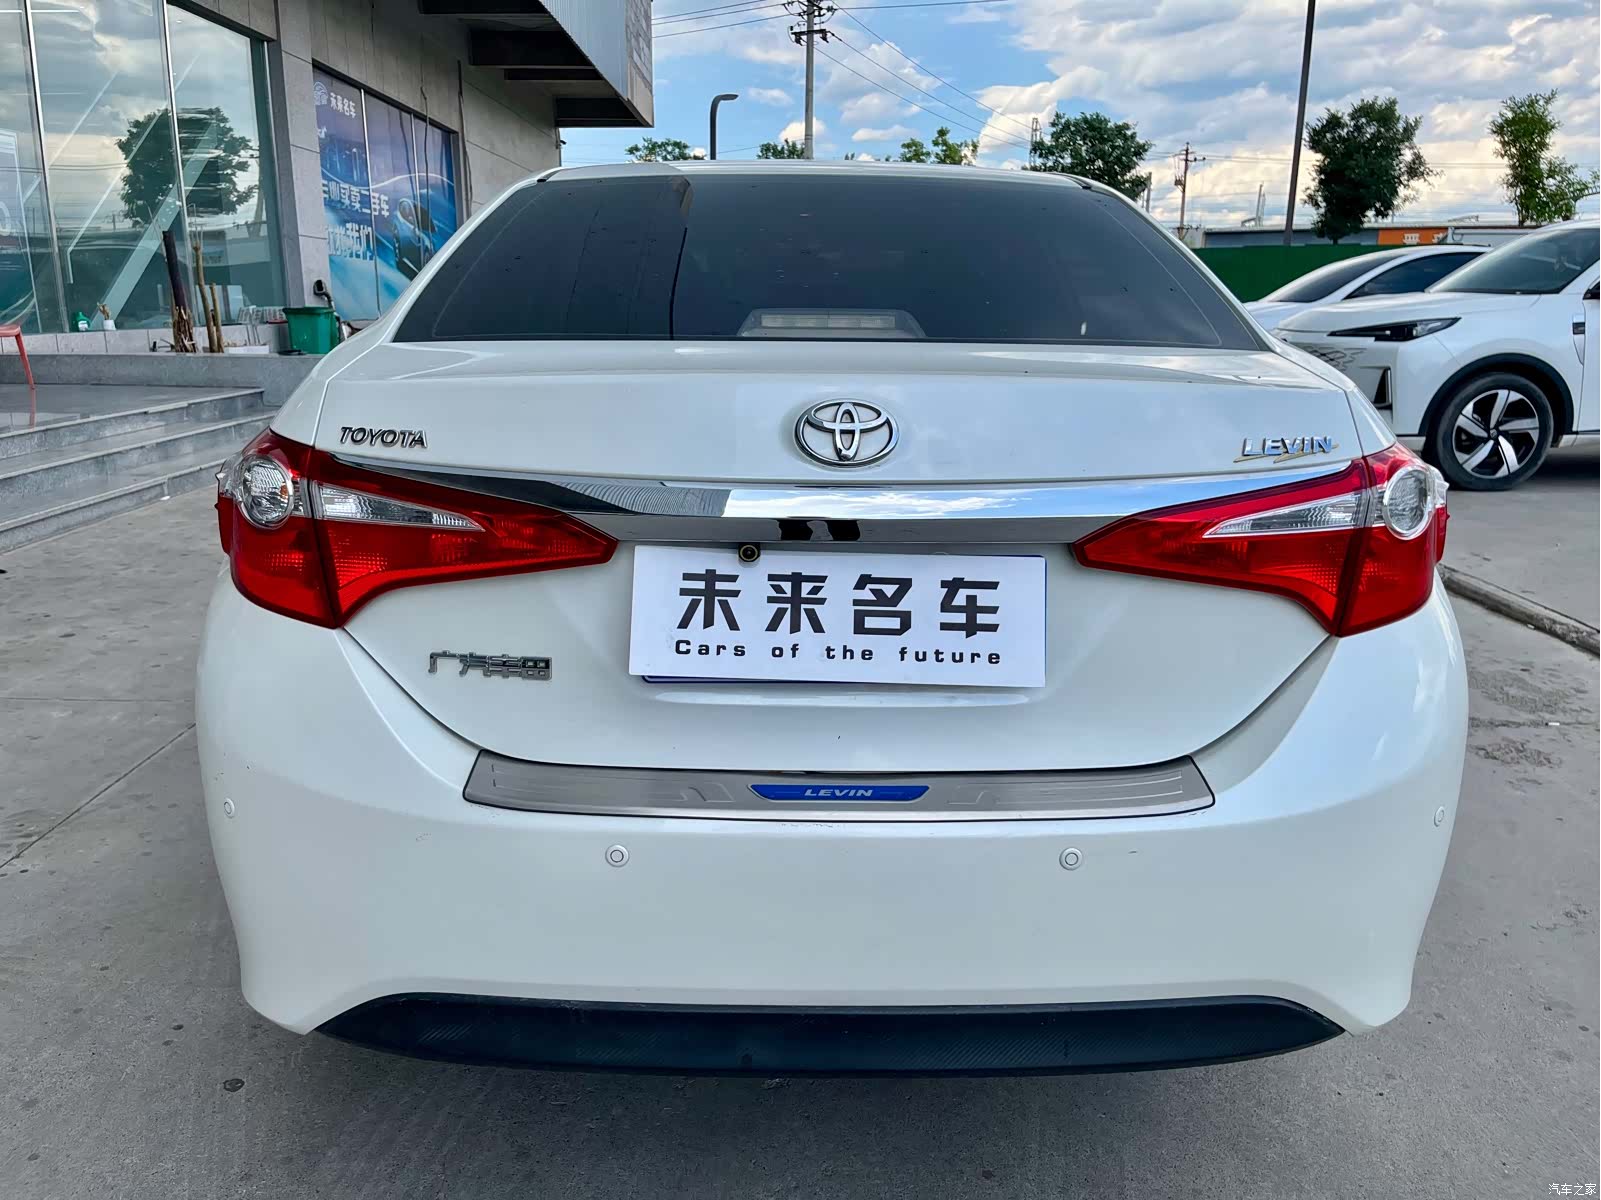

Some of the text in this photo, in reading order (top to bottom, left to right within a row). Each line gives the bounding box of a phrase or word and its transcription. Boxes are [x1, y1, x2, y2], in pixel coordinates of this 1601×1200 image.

[340, 426, 427, 448] TOYOTA
[1242, 436, 1332, 456] LEVIN
[676, 568, 1001, 639] 未来名车
[675, 639, 1001, 664] Cars of the future
[428, 650, 552, 681] 广汽丰田
[804, 789, 873, 797] LEVIN
